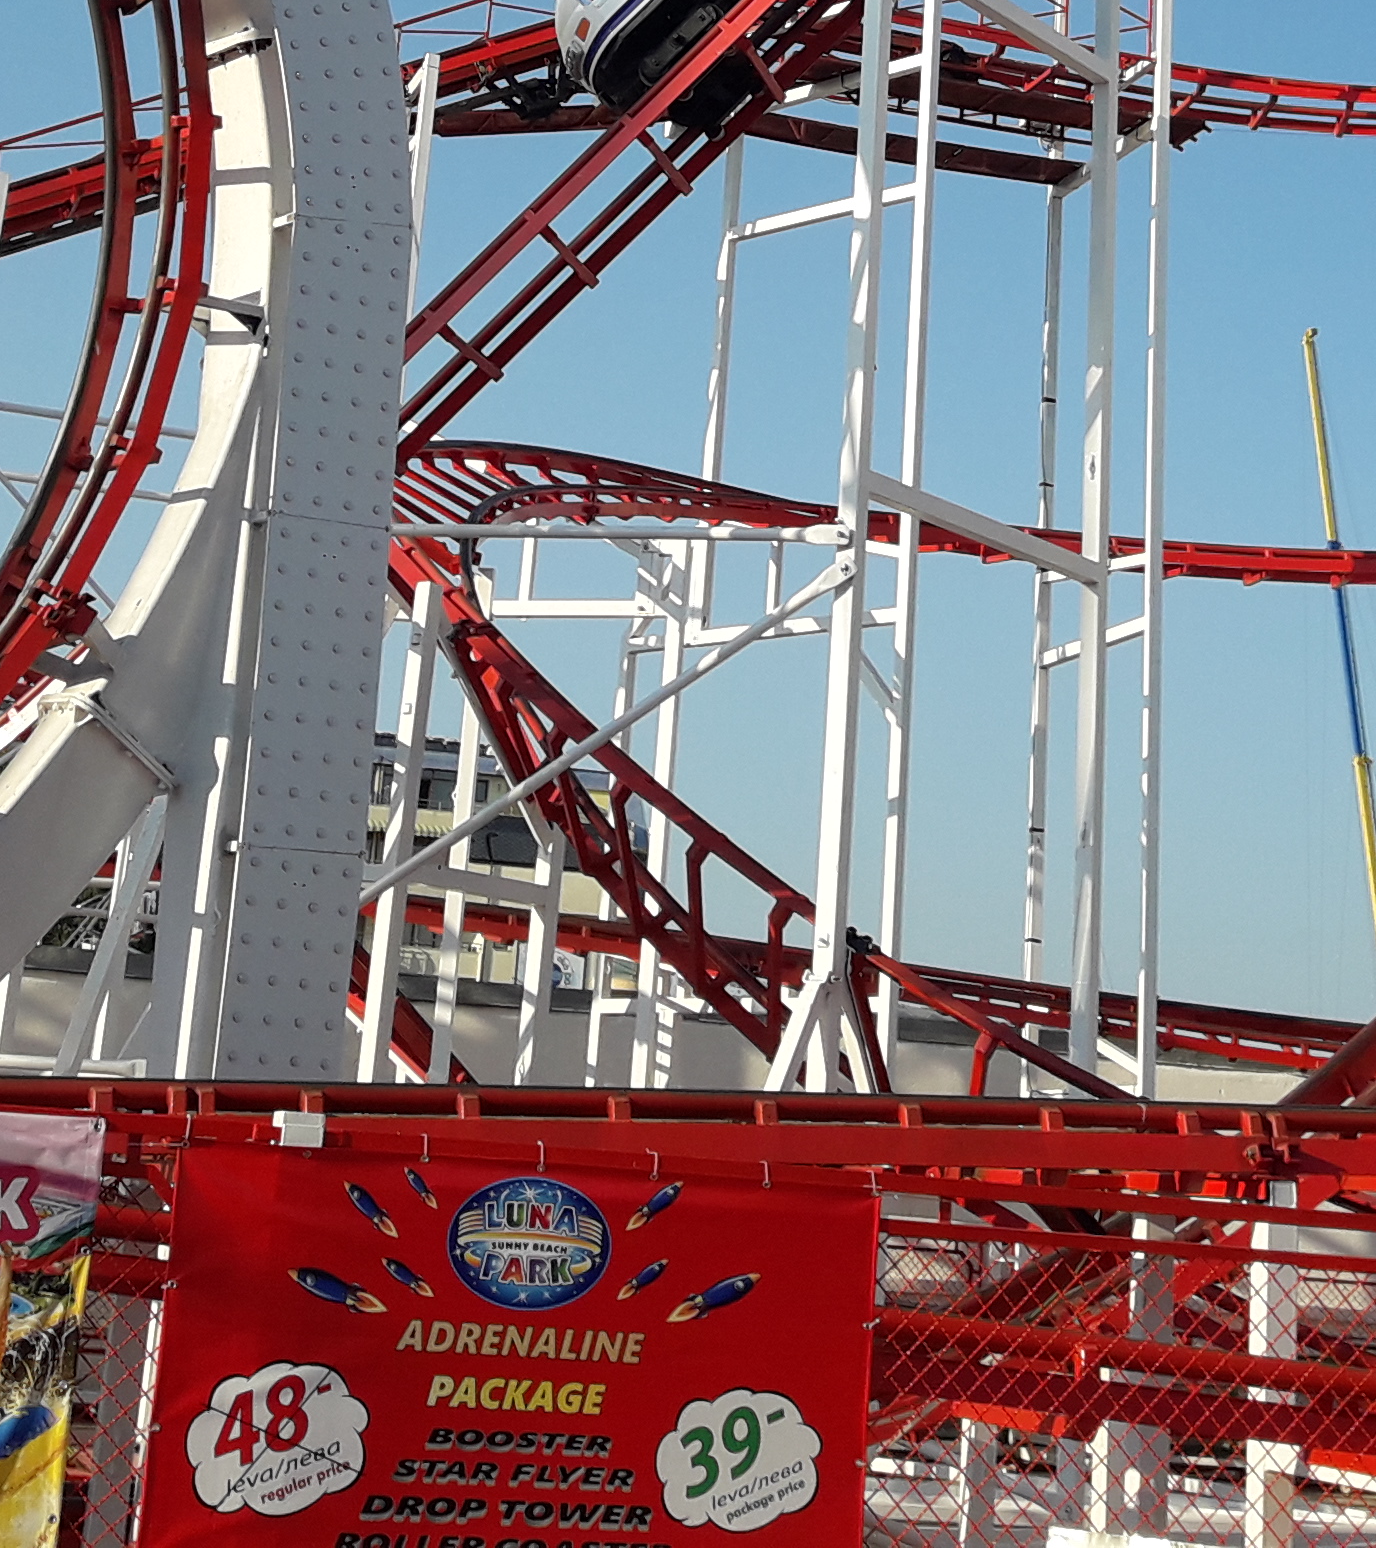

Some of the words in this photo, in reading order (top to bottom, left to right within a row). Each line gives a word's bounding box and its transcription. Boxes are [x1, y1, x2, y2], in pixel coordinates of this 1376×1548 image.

[484, 1201, 579, 1236] LUNA
[491, 1241, 529, 1251] SUNNY
[532, 1242, 568, 1254] BEACH
[479, 1250, 574, 1287] PARK
[395, 1319, 645, 1364] ADRENALINE
[426, 1375, 606, 1415] PACKAGE
[425, 1428, 613, 1457] BOOSTER
[260, 1475, 312, 1504] regular
[317, 1461, 351, 1486] price
[392, 1458, 499, 1487] STAR
[507, 1463, 635, 1493] FLYER
[359, 1494, 488, 1524] DROP
[498, 1499, 653, 1532] TOWER
[726, 1493, 775, 1525] package
[777, 1479, 806, 1501] price
